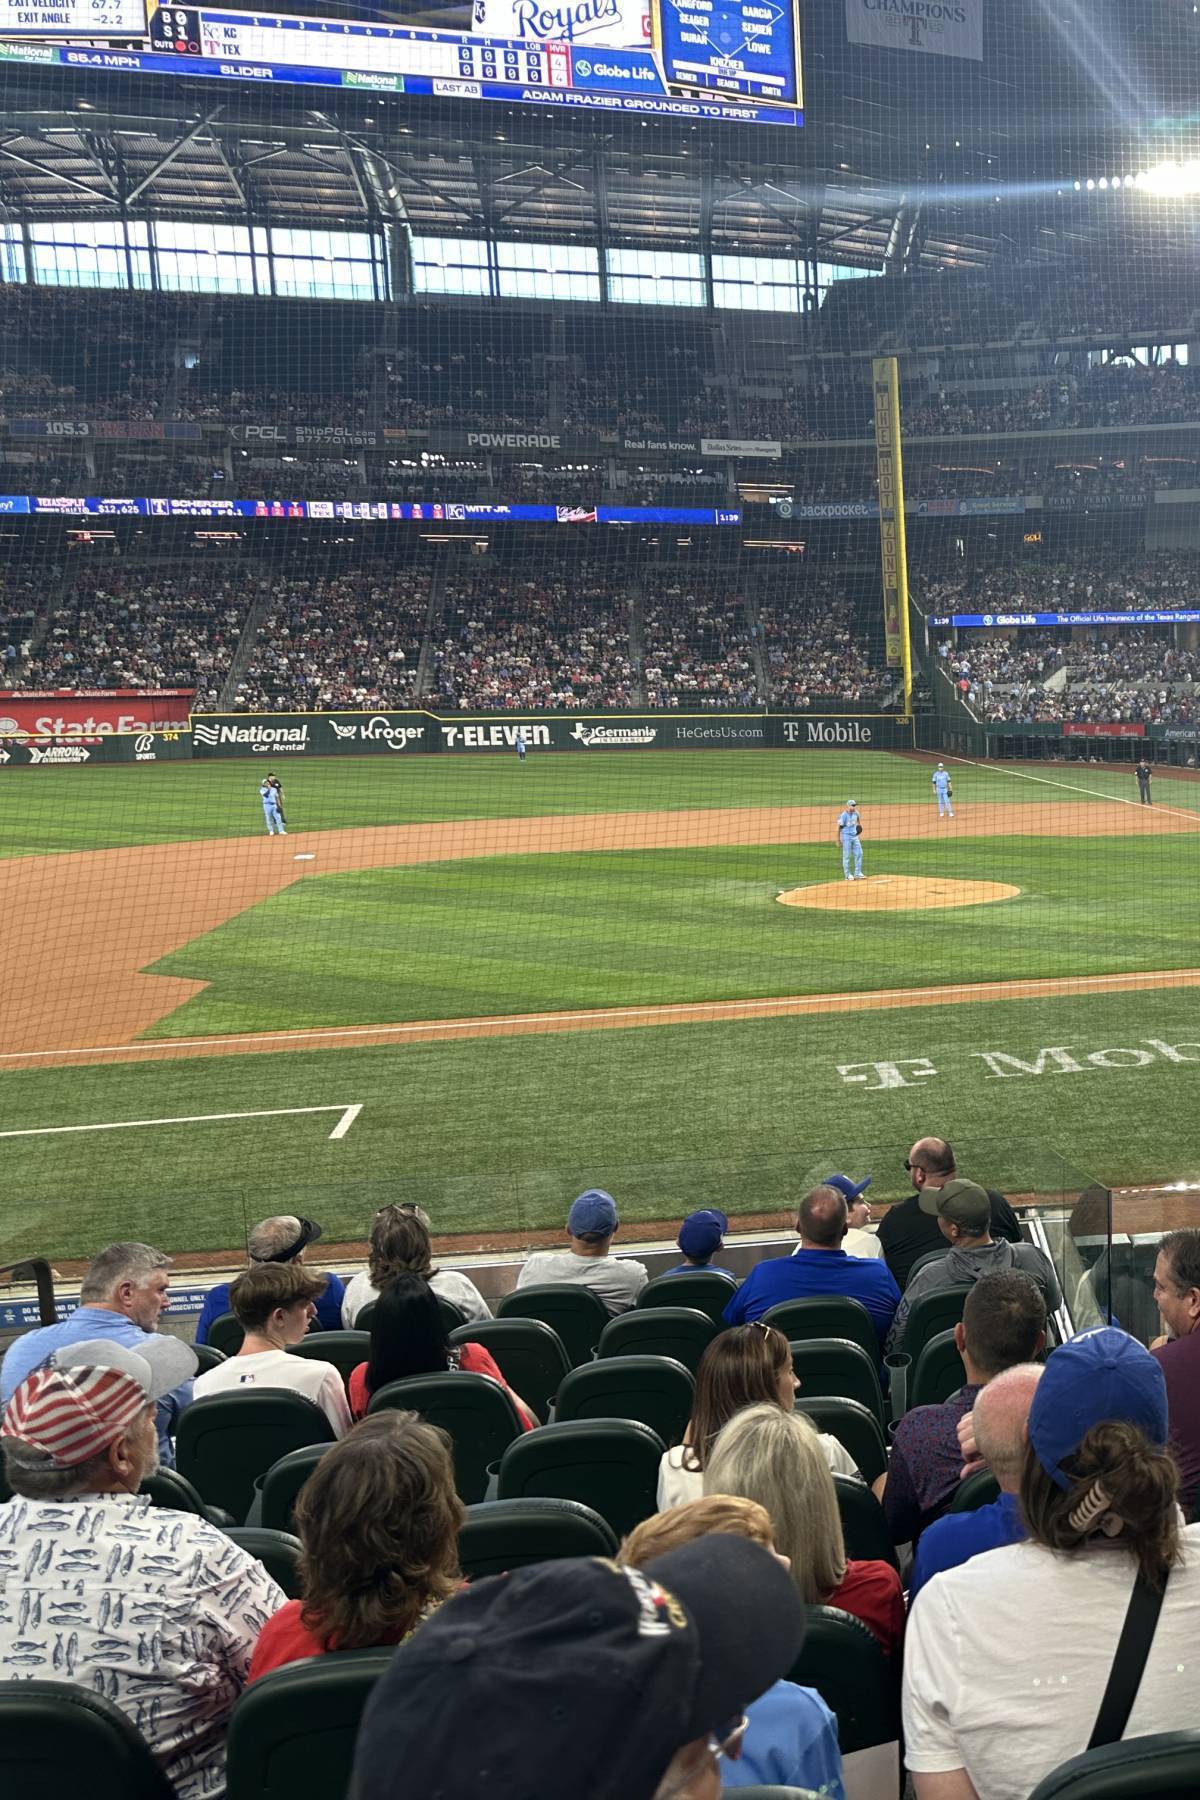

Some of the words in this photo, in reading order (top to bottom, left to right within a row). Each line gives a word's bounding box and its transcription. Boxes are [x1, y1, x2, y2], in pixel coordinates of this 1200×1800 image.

[17, 12, 38, 23] EXIT
[41, 12, 71, 24] ANGLE
[162, 11, 171, 23] B
[162, 26, 172, 38] S
[177, 27, 189, 40] 1
[223, 27, 238, 38] KC
[9, 44, 53, 59] National
[222, 44, 241, 56] TEX
[104, 55, 141, 67] MPH
[220, 64, 274, 79] SLIDER
[593, 63, 630, 80] Globe
[631, 65, 656, 82] Life
[357, 72, 398, 86] National
[435, 83, 461, 95] LAST
[463, 84, 478, 96] AB
[521, 89, 564, 104] ADAM
[565, 93, 622, 110] FRAZIER
[624, 98, 700, 116] GROUNDED
[701, 105, 721, 117] TO
[722, 106, 759, 120] FIRST
[45, 422, 90, 435] 105.3
[245, 425, 287, 440] PGL
[467, 433, 561, 449] POWERADE
[624, 440, 645, 449] Real
[647, 440, 667, 450] fans
[465, 505, 492, 513] WITT
[162, 732, 178, 742] 374
[360, 716, 425, 750] Kroger
[595, 725, 656, 738] Germania
[676, 727, 764, 738] HeGetsUs.com
[783, 721, 799, 742] T
[806, 722, 872, 743] Mobile
[1165, 729, 1196, 738] American
[43, 746, 81, 758] ARROW
[252, 743, 270, 752] Car
[273, 742, 306, 751] Rental
